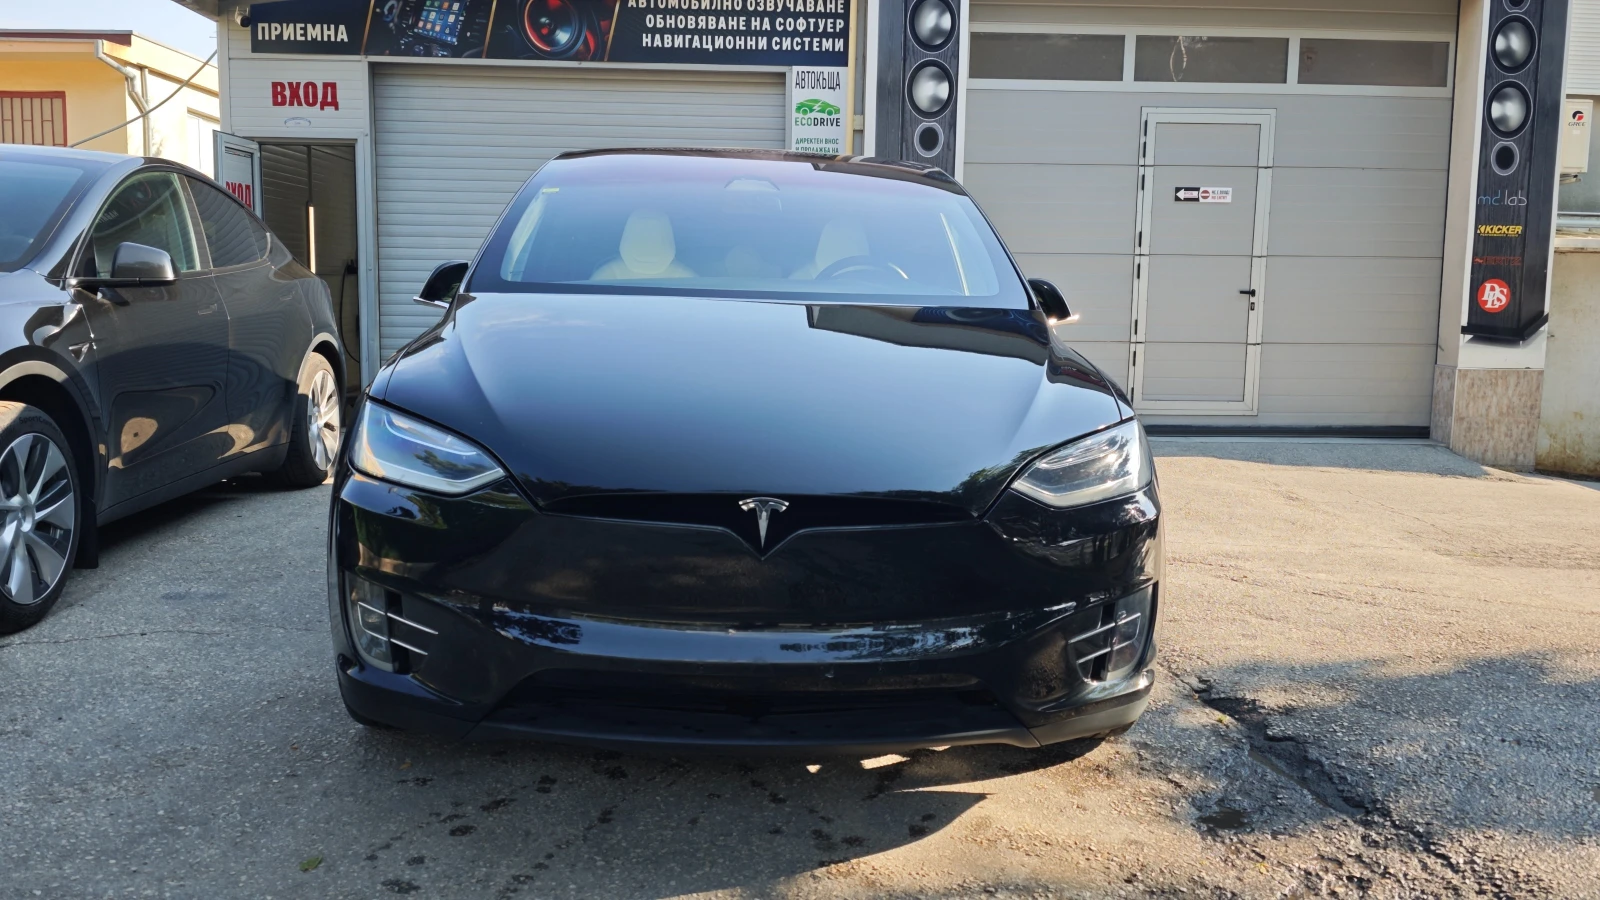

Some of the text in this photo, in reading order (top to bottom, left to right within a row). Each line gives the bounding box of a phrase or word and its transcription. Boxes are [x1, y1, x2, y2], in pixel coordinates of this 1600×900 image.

[628, 0, 845, 13] АВТОМОБИЛНО ОЗВУЧАВАНЕ
[256, 22, 349, 42] ПРИЕМНА
[645, 14, 845, 33] ОБНОВЯВАНЕ НА СОФТУЕР
[642, 33, 844, 52] НАВИГАЦИОННИ СИСТЕМИ
[795, 70, 841, 91] АВТОКЪЩА
[271, 81, 339, 111] ВХОД
[795, 117, 840, 126] ECODRIVE
[795, 137, 824, 145] ДИРЕКТЕН
[1484, 225, 1523, 234] KICKER
